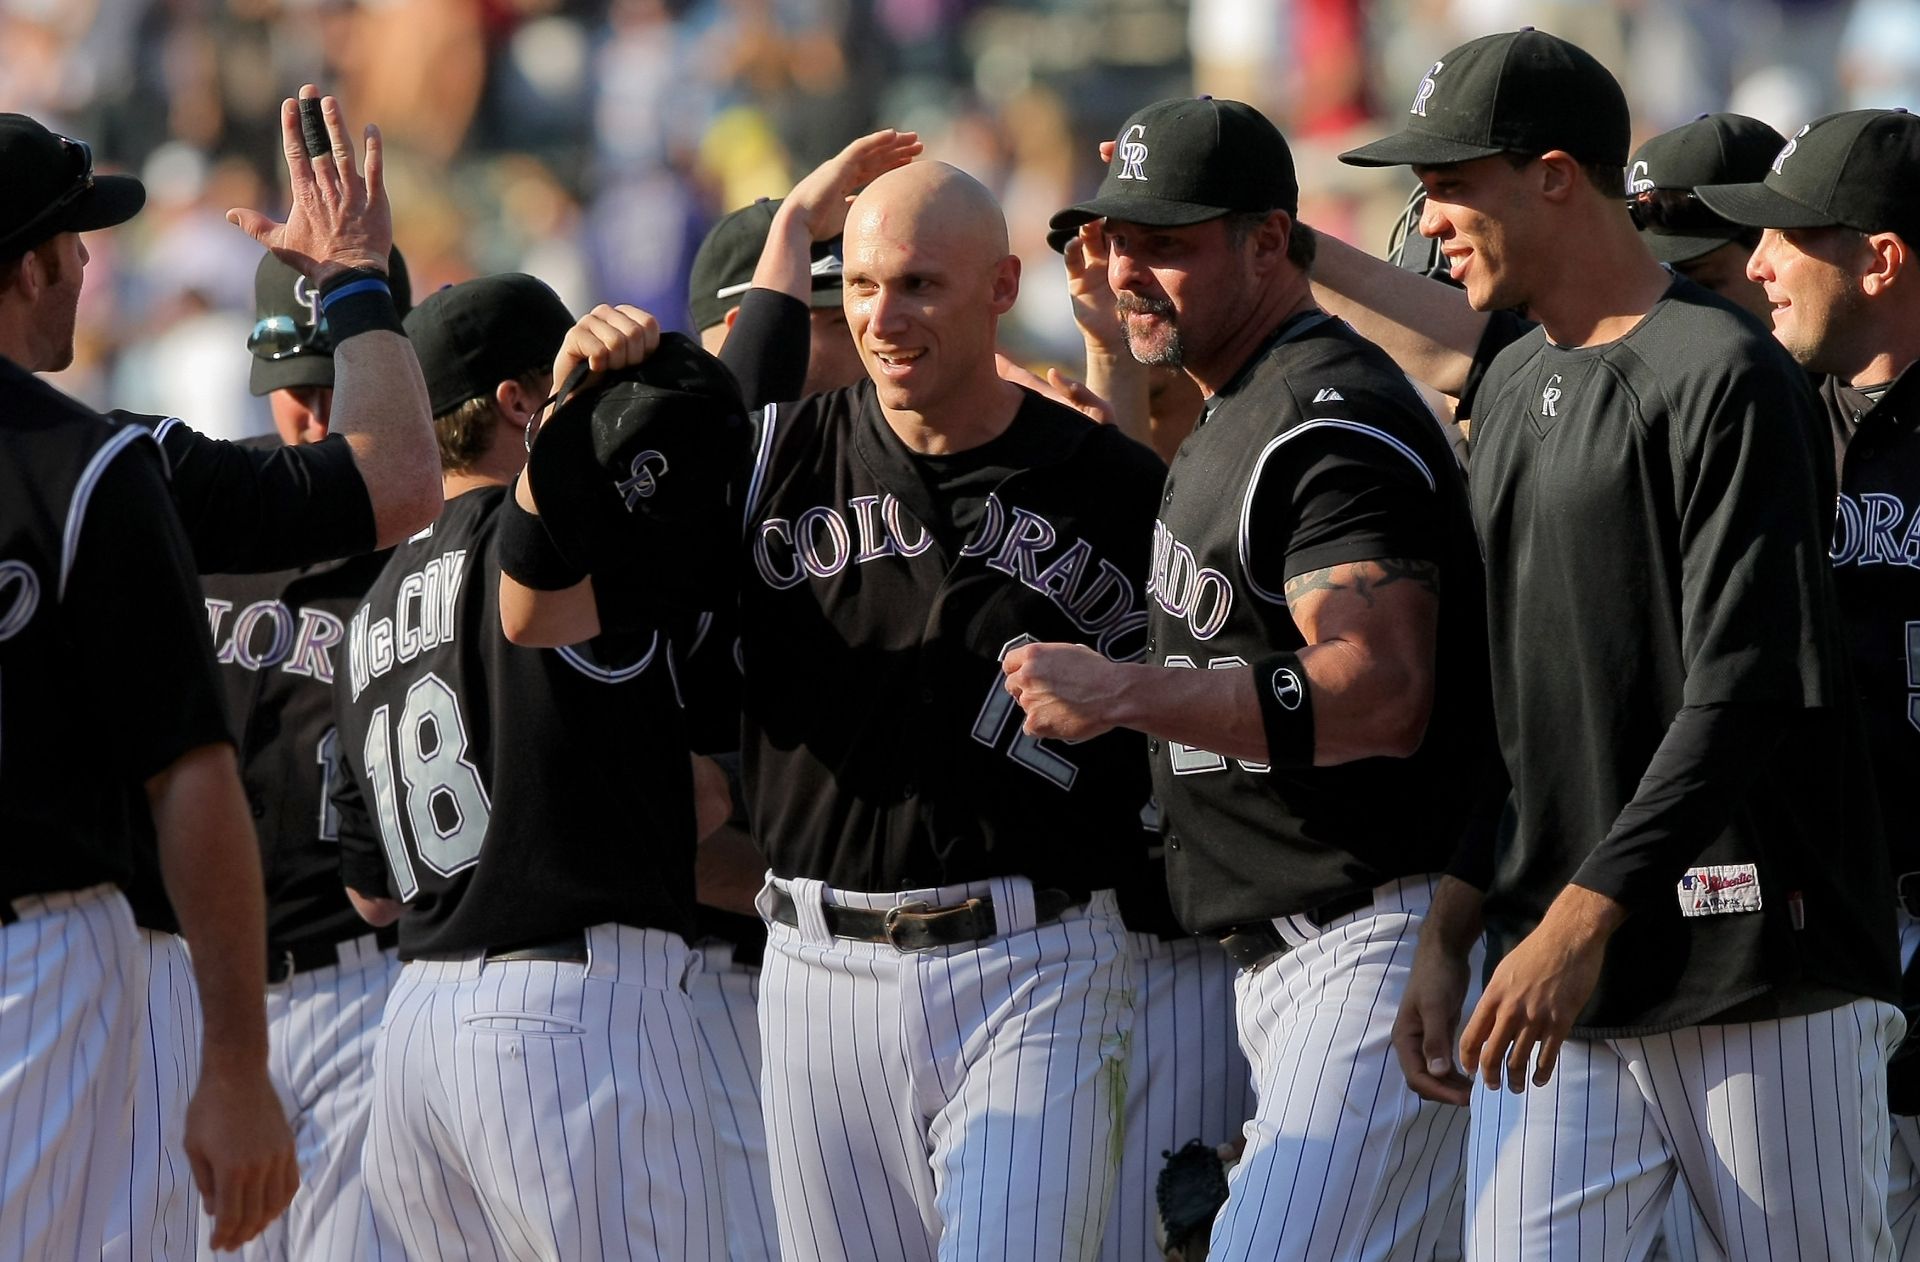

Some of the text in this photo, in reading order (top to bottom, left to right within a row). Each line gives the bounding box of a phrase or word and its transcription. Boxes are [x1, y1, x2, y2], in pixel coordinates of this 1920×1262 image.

[1117, 123, 1149, 182] CR
[1541, 373, 1563, 417] CR
[364, 671, 492, 903] 18
